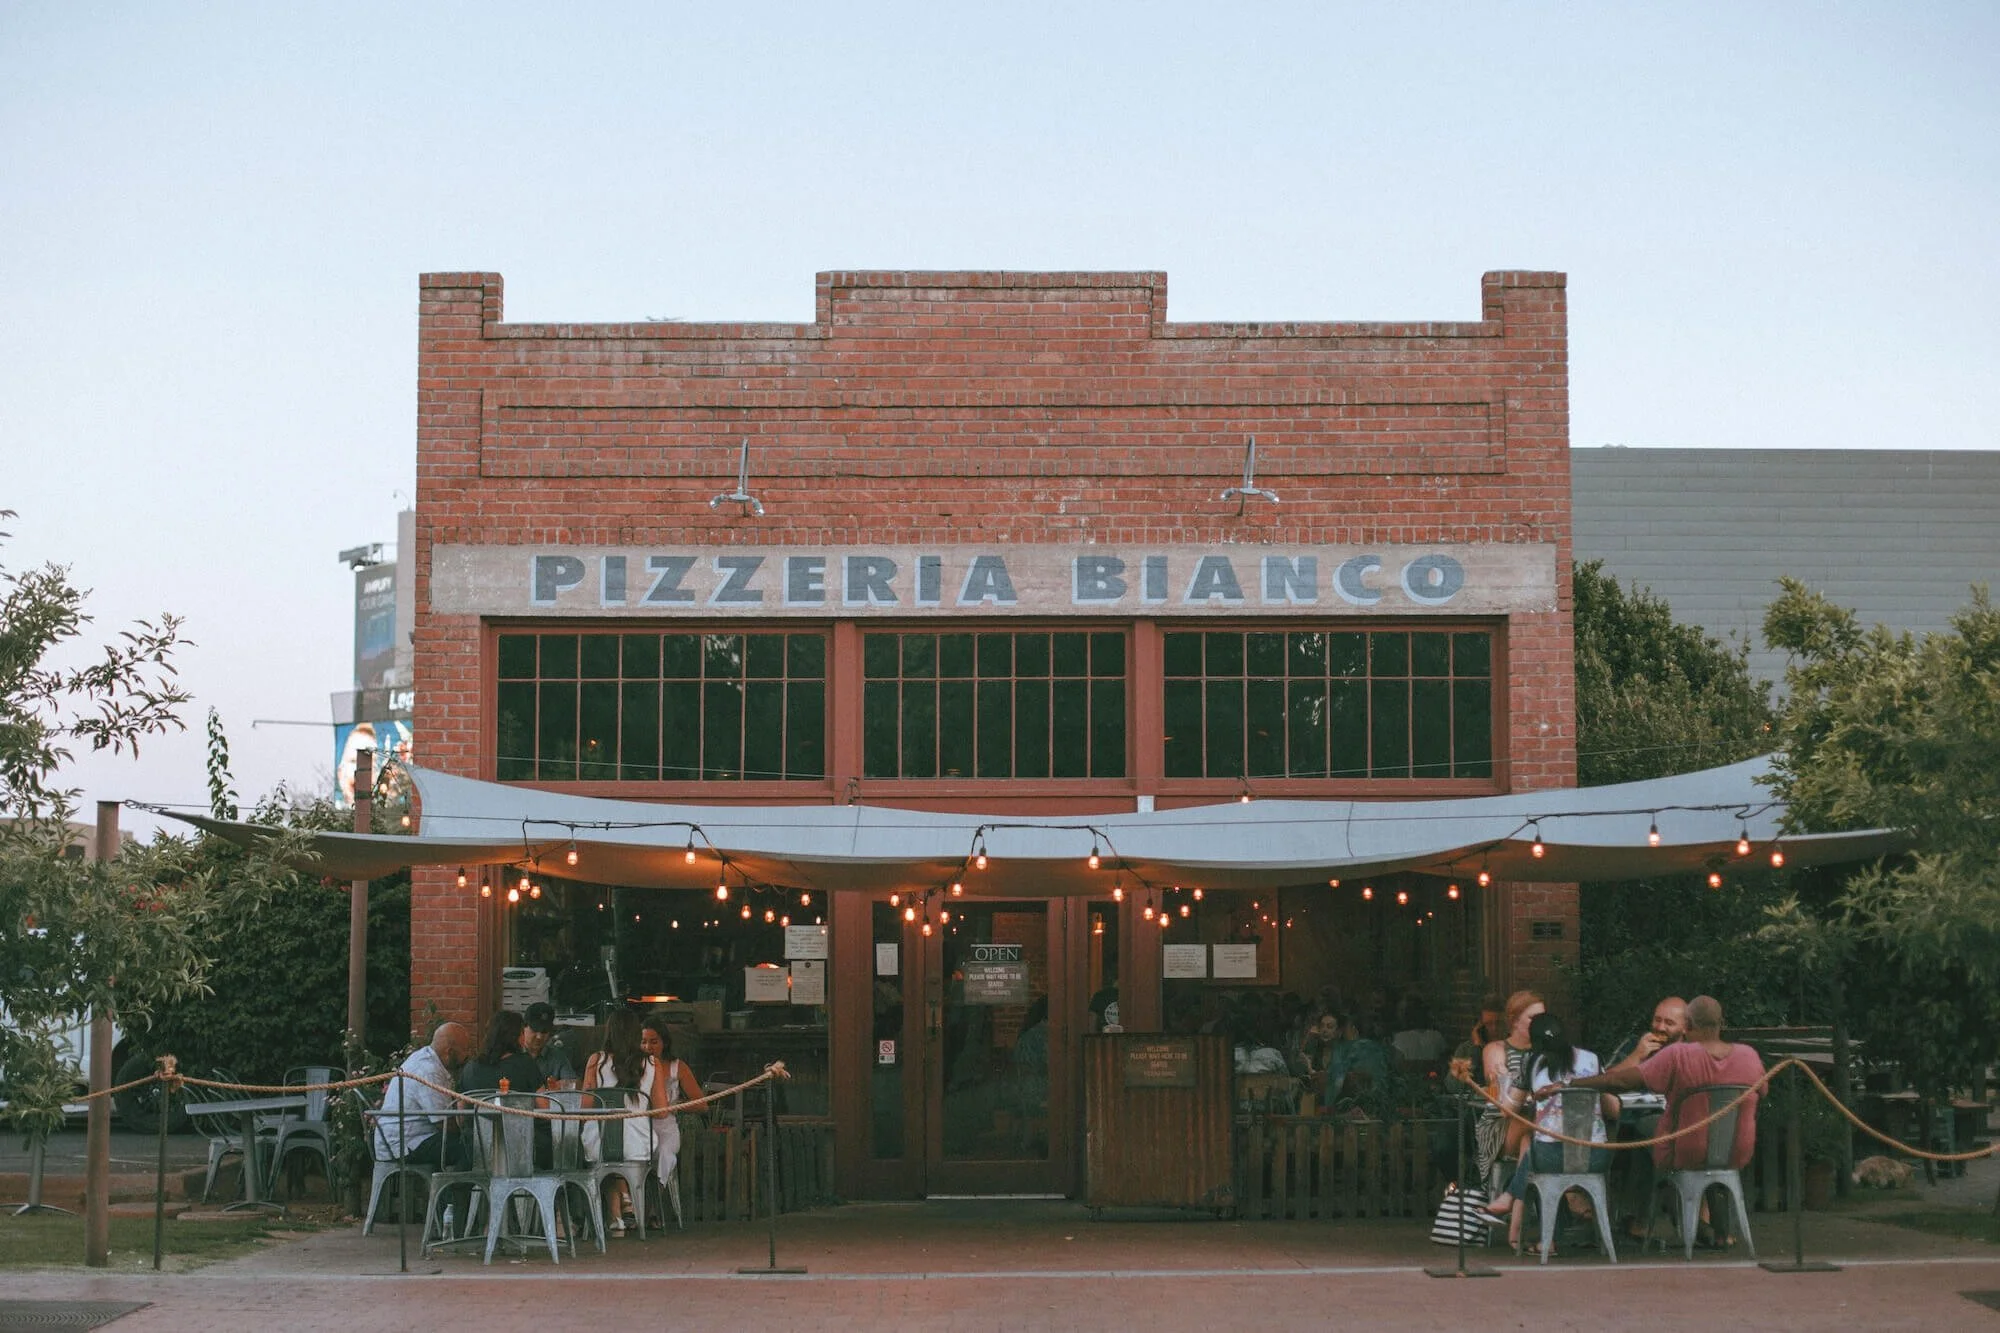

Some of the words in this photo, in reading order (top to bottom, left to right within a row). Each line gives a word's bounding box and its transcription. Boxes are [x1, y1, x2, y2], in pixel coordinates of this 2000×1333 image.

[530, 555, 1018, 608] PIZZERIA
[1072, 554, 1464, 605] BIANCO
[975, 948, 1018, 961] OPEN
